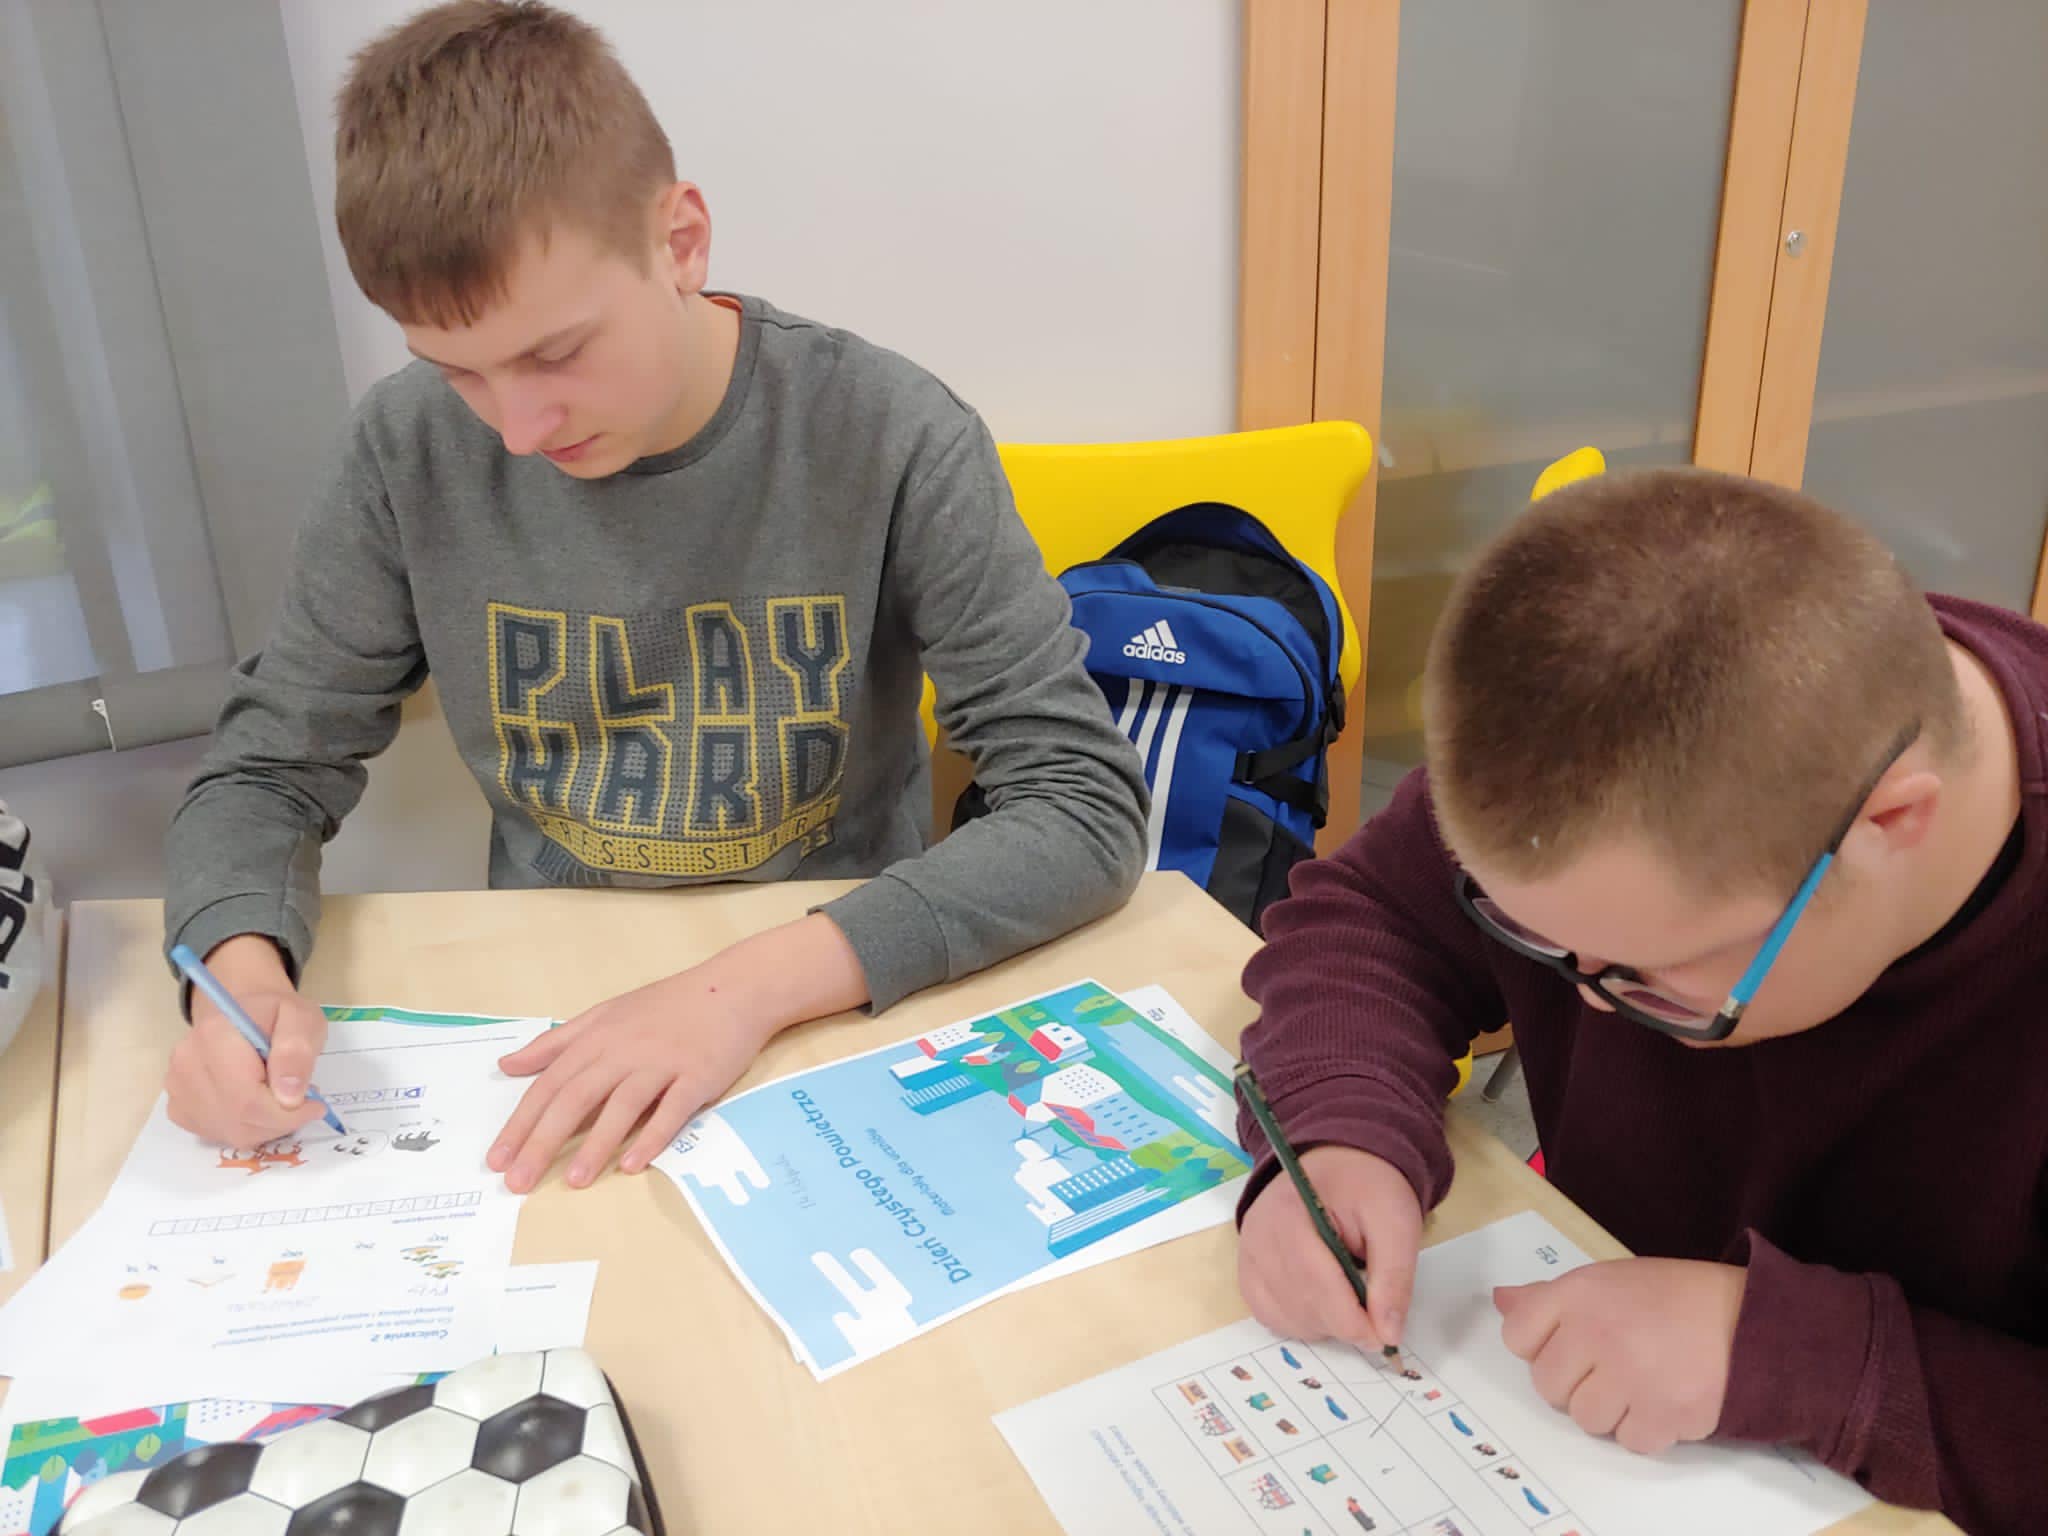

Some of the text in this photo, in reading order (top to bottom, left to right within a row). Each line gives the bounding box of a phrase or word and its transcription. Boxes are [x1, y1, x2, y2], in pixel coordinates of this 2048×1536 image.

[487, 595, 850, 728] PLAY
[1123, 644, 1187, 664] adidas
[494, 717, 851, 837] HARD
[541, 801, 835, 870] PRESS START
[791, 1089, 862, 1169] Powietrza
[897, 1160, 914, 1176] dla
[855, 1168, 926, 1238] Czystego
[915, 1236, 972, 1284] Dzień
